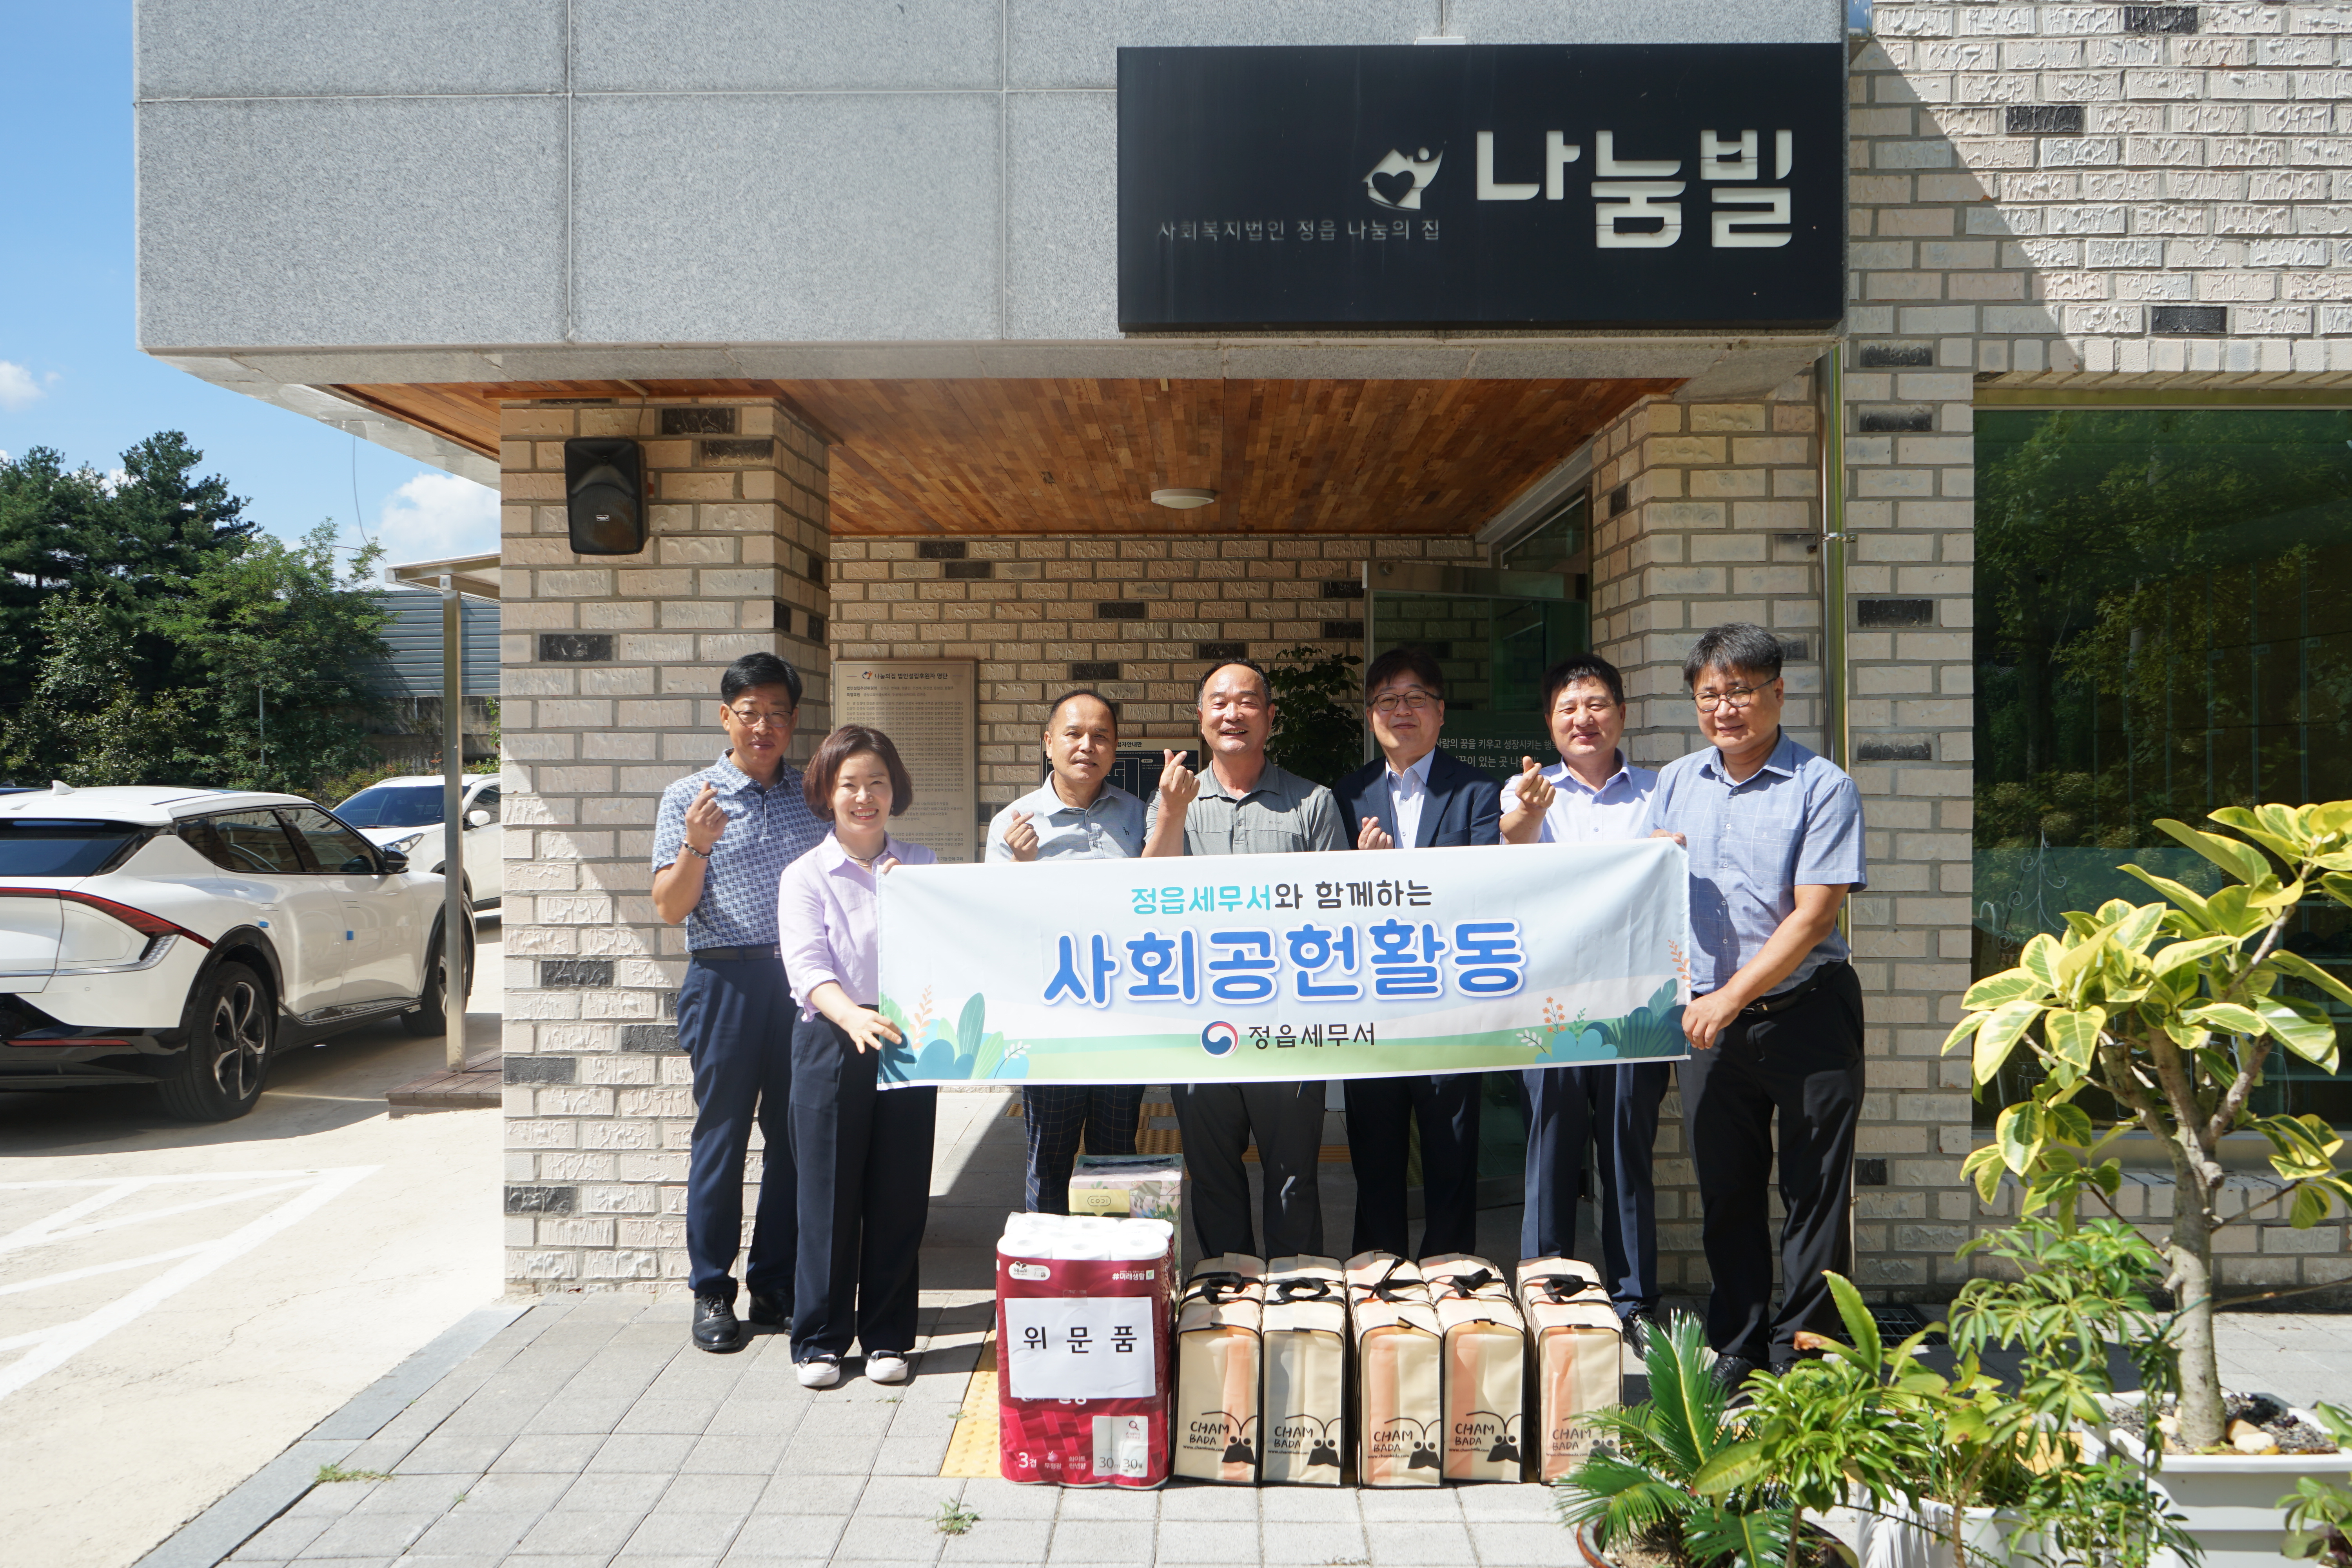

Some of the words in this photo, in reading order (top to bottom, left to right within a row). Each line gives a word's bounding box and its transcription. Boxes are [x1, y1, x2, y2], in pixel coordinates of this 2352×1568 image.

[1476, 129, 1793, 249] 나눔빌
[1158, 220, 1285, 241] 사회복지법인
[1297, 220, 1337, 241] 정읍
[1348, 219, 1410, 241] 나눔의
[1421, 220, 1439, 240] 집
[1460, 739, 1476, 749] 꿈을
[1479, 739, 1501, 749] 키우고
[1504, 739, 1542, 750] 성장시키는
[1479, 756, 1497, 768] 있는
[1499, 756, 1508, 768] 곳
[1131, 883, 1303, 915] 정읍세무서와
[1315, 879, 1432, 909] 함께하는
[1042, 917, 1523, 1005] 사회공헌활동
[1249, 1022, 1374, 1050] 정읍세무서
[1190, 1421, 1229, 1434] CHAM
[1274, 1426, 1313, 1438] CHAM
[1455, 1423, 1494, 1435] CHAM
[1189, 1433, 1216, 1445] BADA
[1374, 1430, 1413, 1442] CHAM
[1552, 1428, 1591, 1440] CHAM
[1274, 1438, 1301, 1448] BADA
[1455, 1436, 1482, 1446] BADA
[1552, 1441, 1579, 1451] BADA
[1374, 1443, 1401, 1453] BADA
[1019, 1452, 1037, 1468] 3겹
